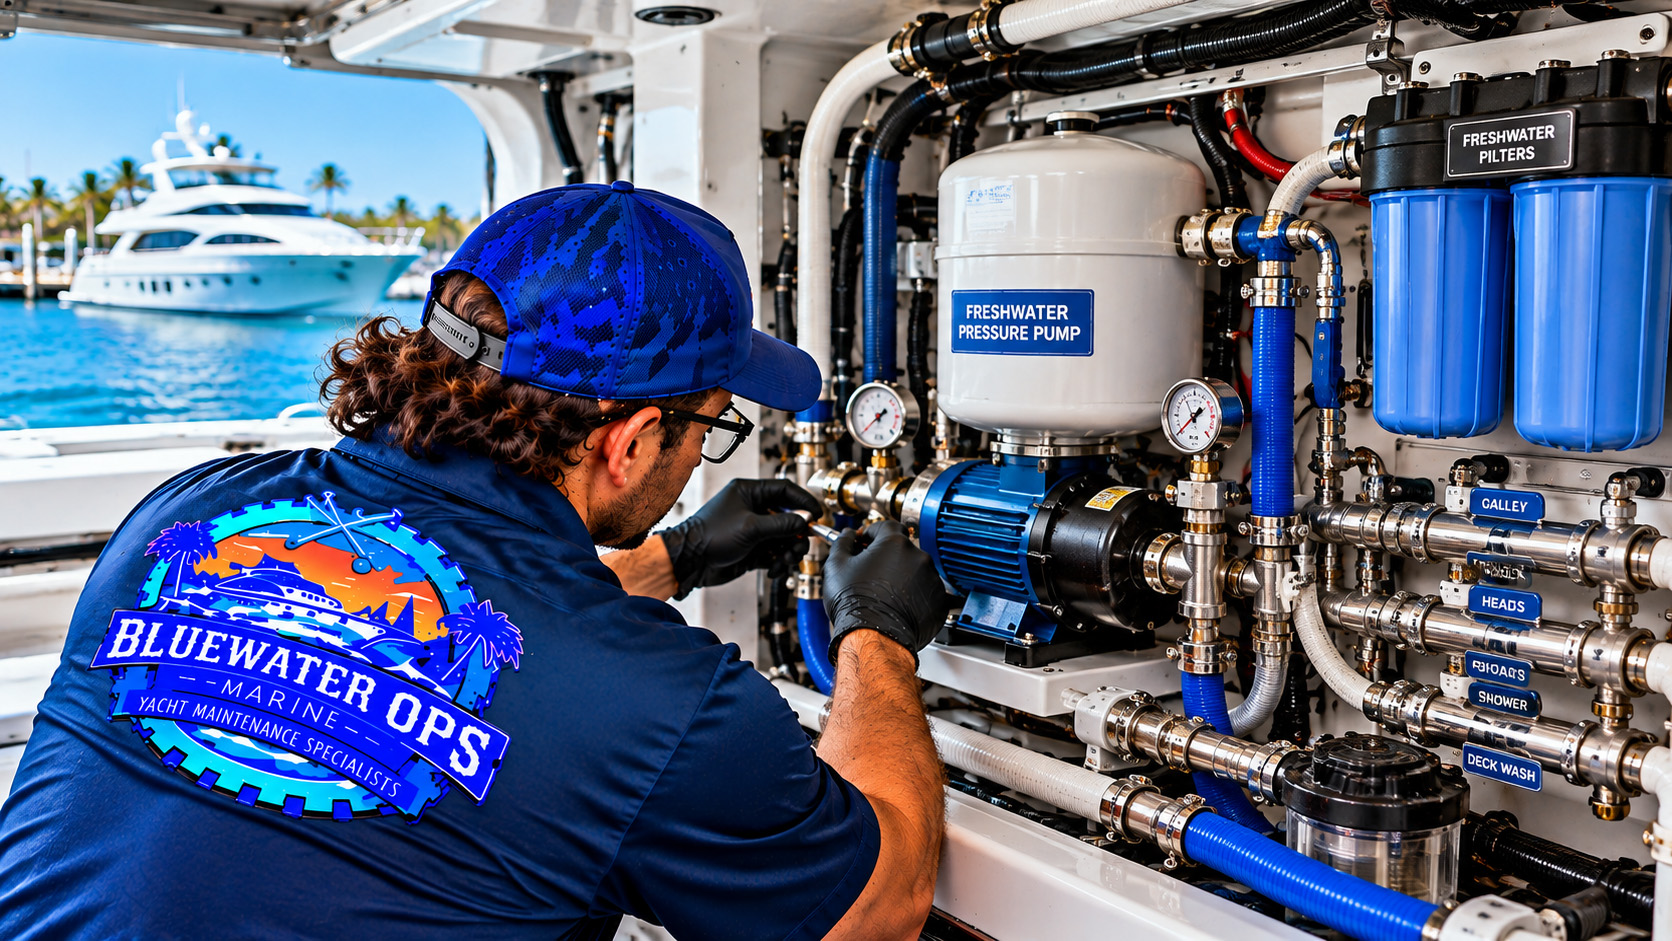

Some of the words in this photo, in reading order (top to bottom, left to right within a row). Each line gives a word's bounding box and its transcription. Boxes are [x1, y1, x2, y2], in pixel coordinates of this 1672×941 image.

[1462, 124, 1555, 148] FRESHWATER
[966, 304, 1069, 321] FRESHWATER
[958, 324, 1029, 341] PRESSURE
[1033, 325, 1081, 342] PUMP
[1481, 497, 1529, 513] GALLEY
[1482, 595, 1526, 613] HEADS
[107, 617, 378, 713] BLUEWATER
[384, 691, 492, 778] OPS
[220, 678, 340, 730] MARINE
[1478, 690, 1528, 711] SHOWER
[138, 696, 190, 716] YACHT
[191, 702, 302, 748] MAINTENANCE
[303, 737, 402, 798] SPECIALISTS
[1467, 752, 1498, 772] DECK
[1500, 761, 1536, 783] WASH
